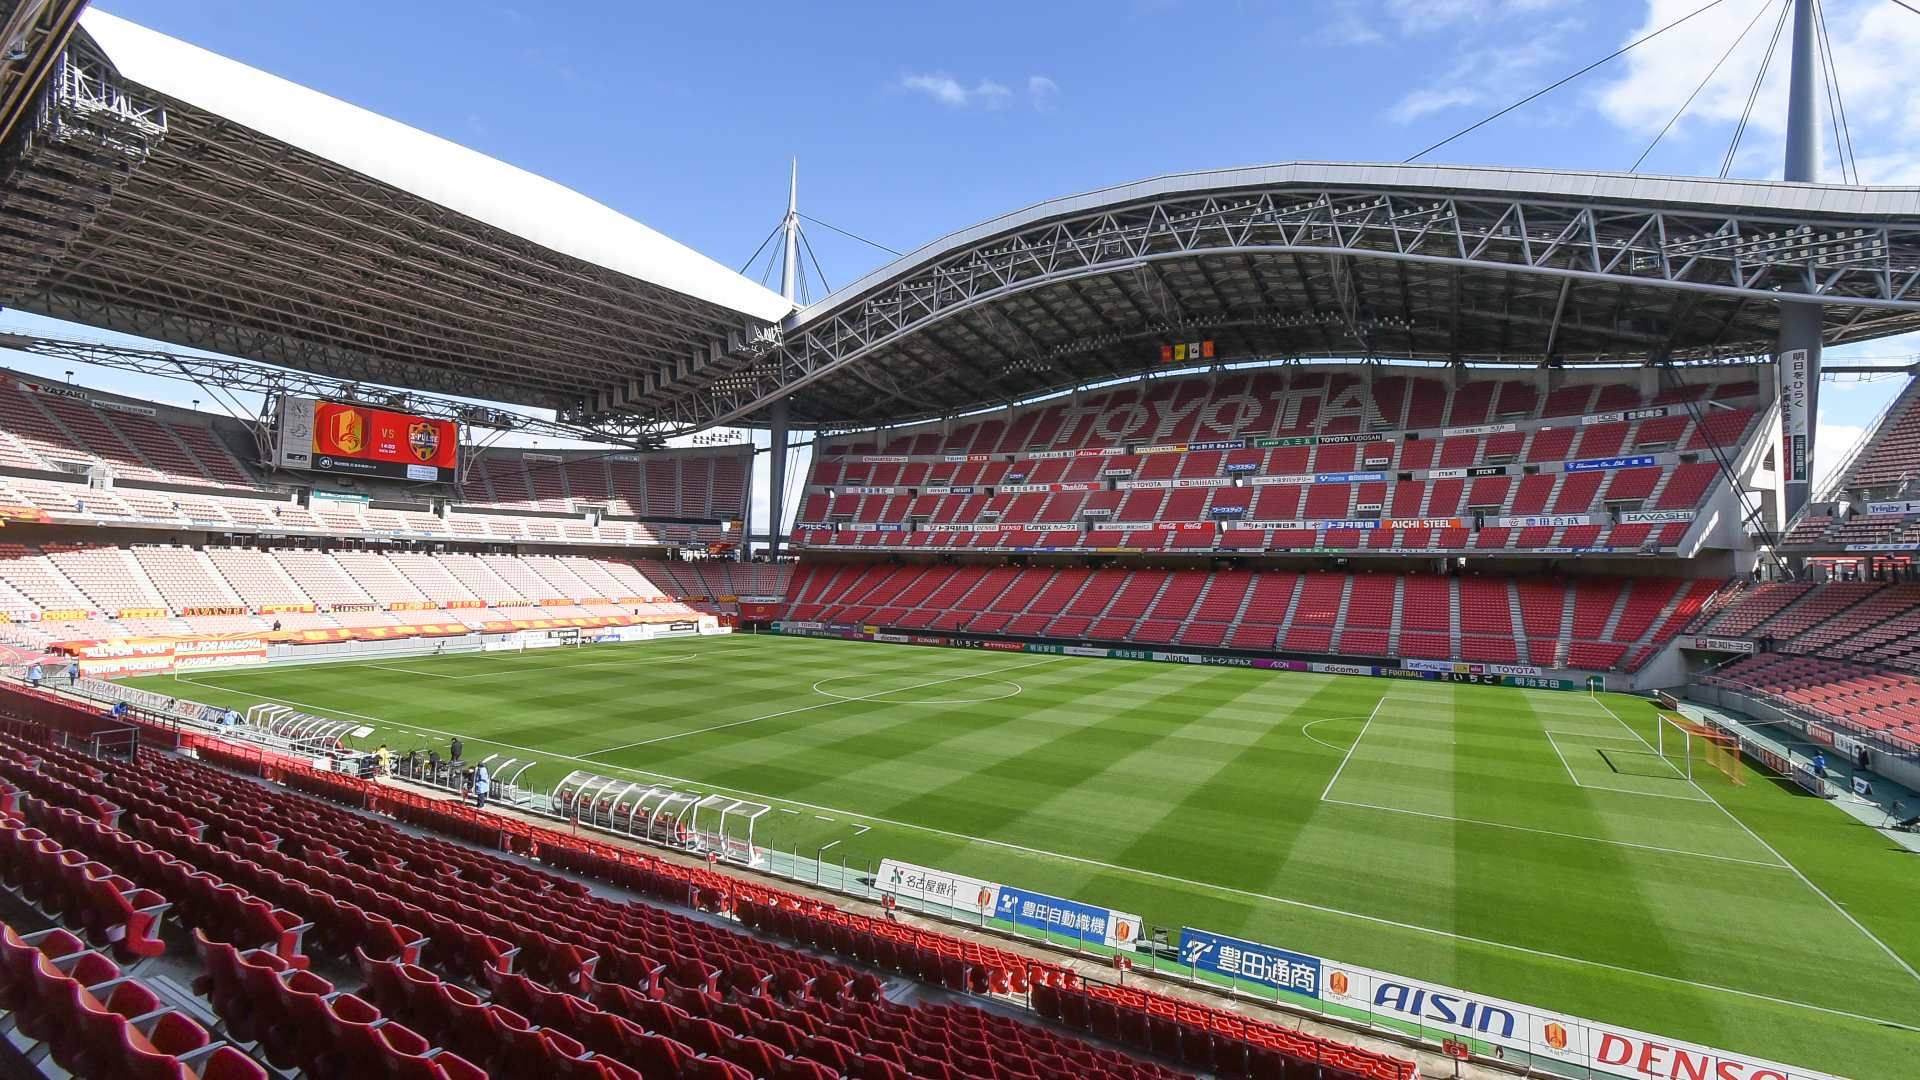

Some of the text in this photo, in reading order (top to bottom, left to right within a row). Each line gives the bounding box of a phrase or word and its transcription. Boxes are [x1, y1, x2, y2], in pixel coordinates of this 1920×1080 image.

[1792, 351, 1805, 408] 明日をひらく
[43, 385, 88, 400] YAZAKI
[1059, 384, 1396, 443] TOYOTA
[381, 427, 395, 439] VS
[1321, 436, 1349, 444] TOYOTA
[1871, 504, 1900, 513] Trinity
[1627, 512, 1692, 523] HAYASHI
[1391, 519, 1452, 529] AICHI STEEL
[1165, 655, 1190, 663] AIDEM
[1324, 663, 1360, 675] docomo
[1496, 665, 1536, 675] TOYOTA
[1453, 673, 1495, 685] いちご
[1515, 677, 1560, 689] 明治安田
[905, 875, 958, 897] 名古屋銀行
[1022, 900, 1106, 936] 豊田自動織機
[1217, 945, 1316, 993] 豊田通商
[1373, 982, 1515, 1039] AISIN
